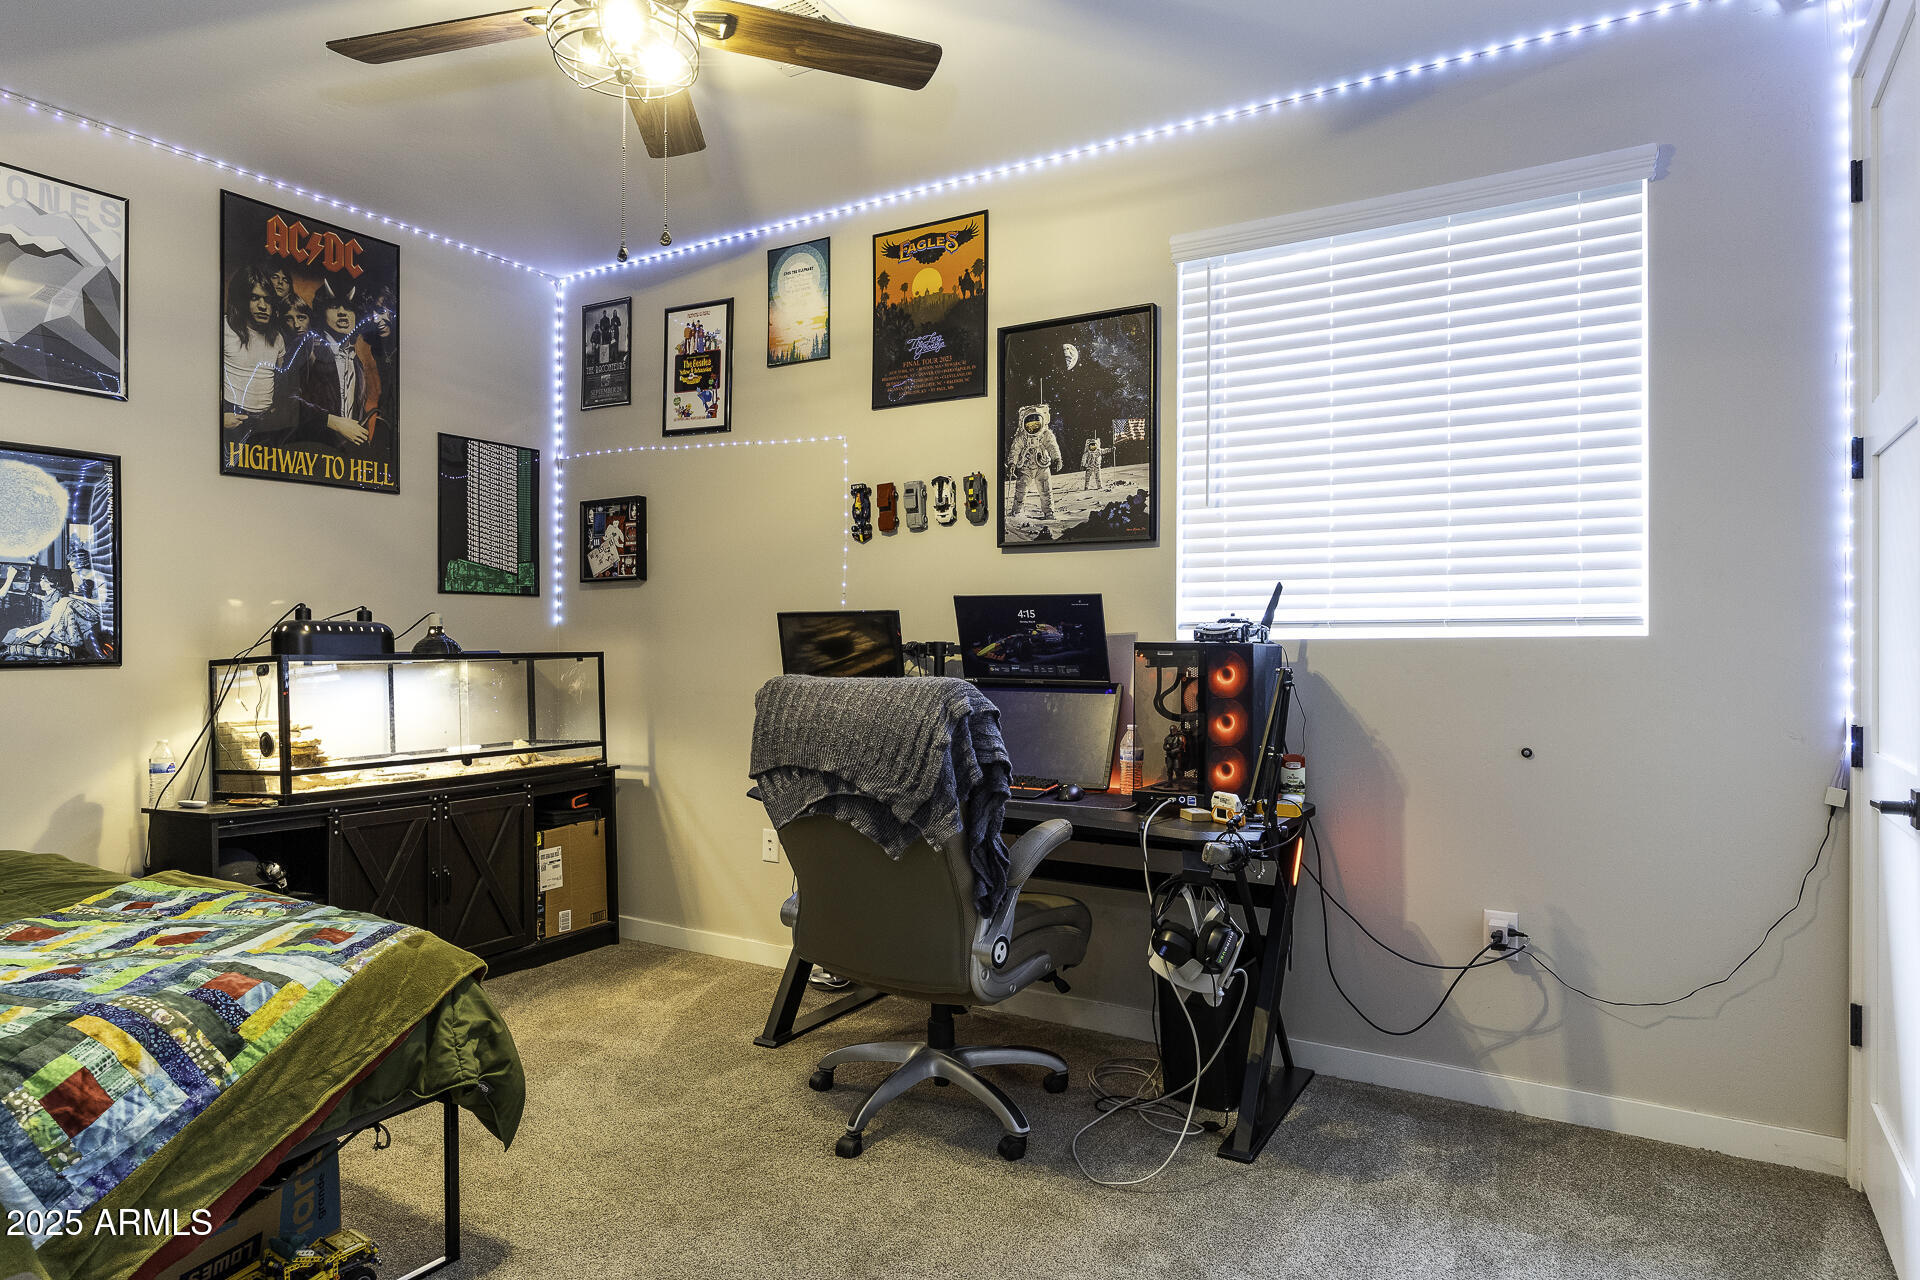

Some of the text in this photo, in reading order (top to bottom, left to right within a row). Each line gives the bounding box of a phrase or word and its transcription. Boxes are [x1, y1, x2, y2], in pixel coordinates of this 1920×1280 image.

[0, 168, 121, 229] ONES
[903, 360, 920, 368] FINAL
[229, 441, 394, 486] HIGHWAY TO HELL
[1018, 609, 1035, 618] 4:15
[318, 1173, 326, 1220] grande
